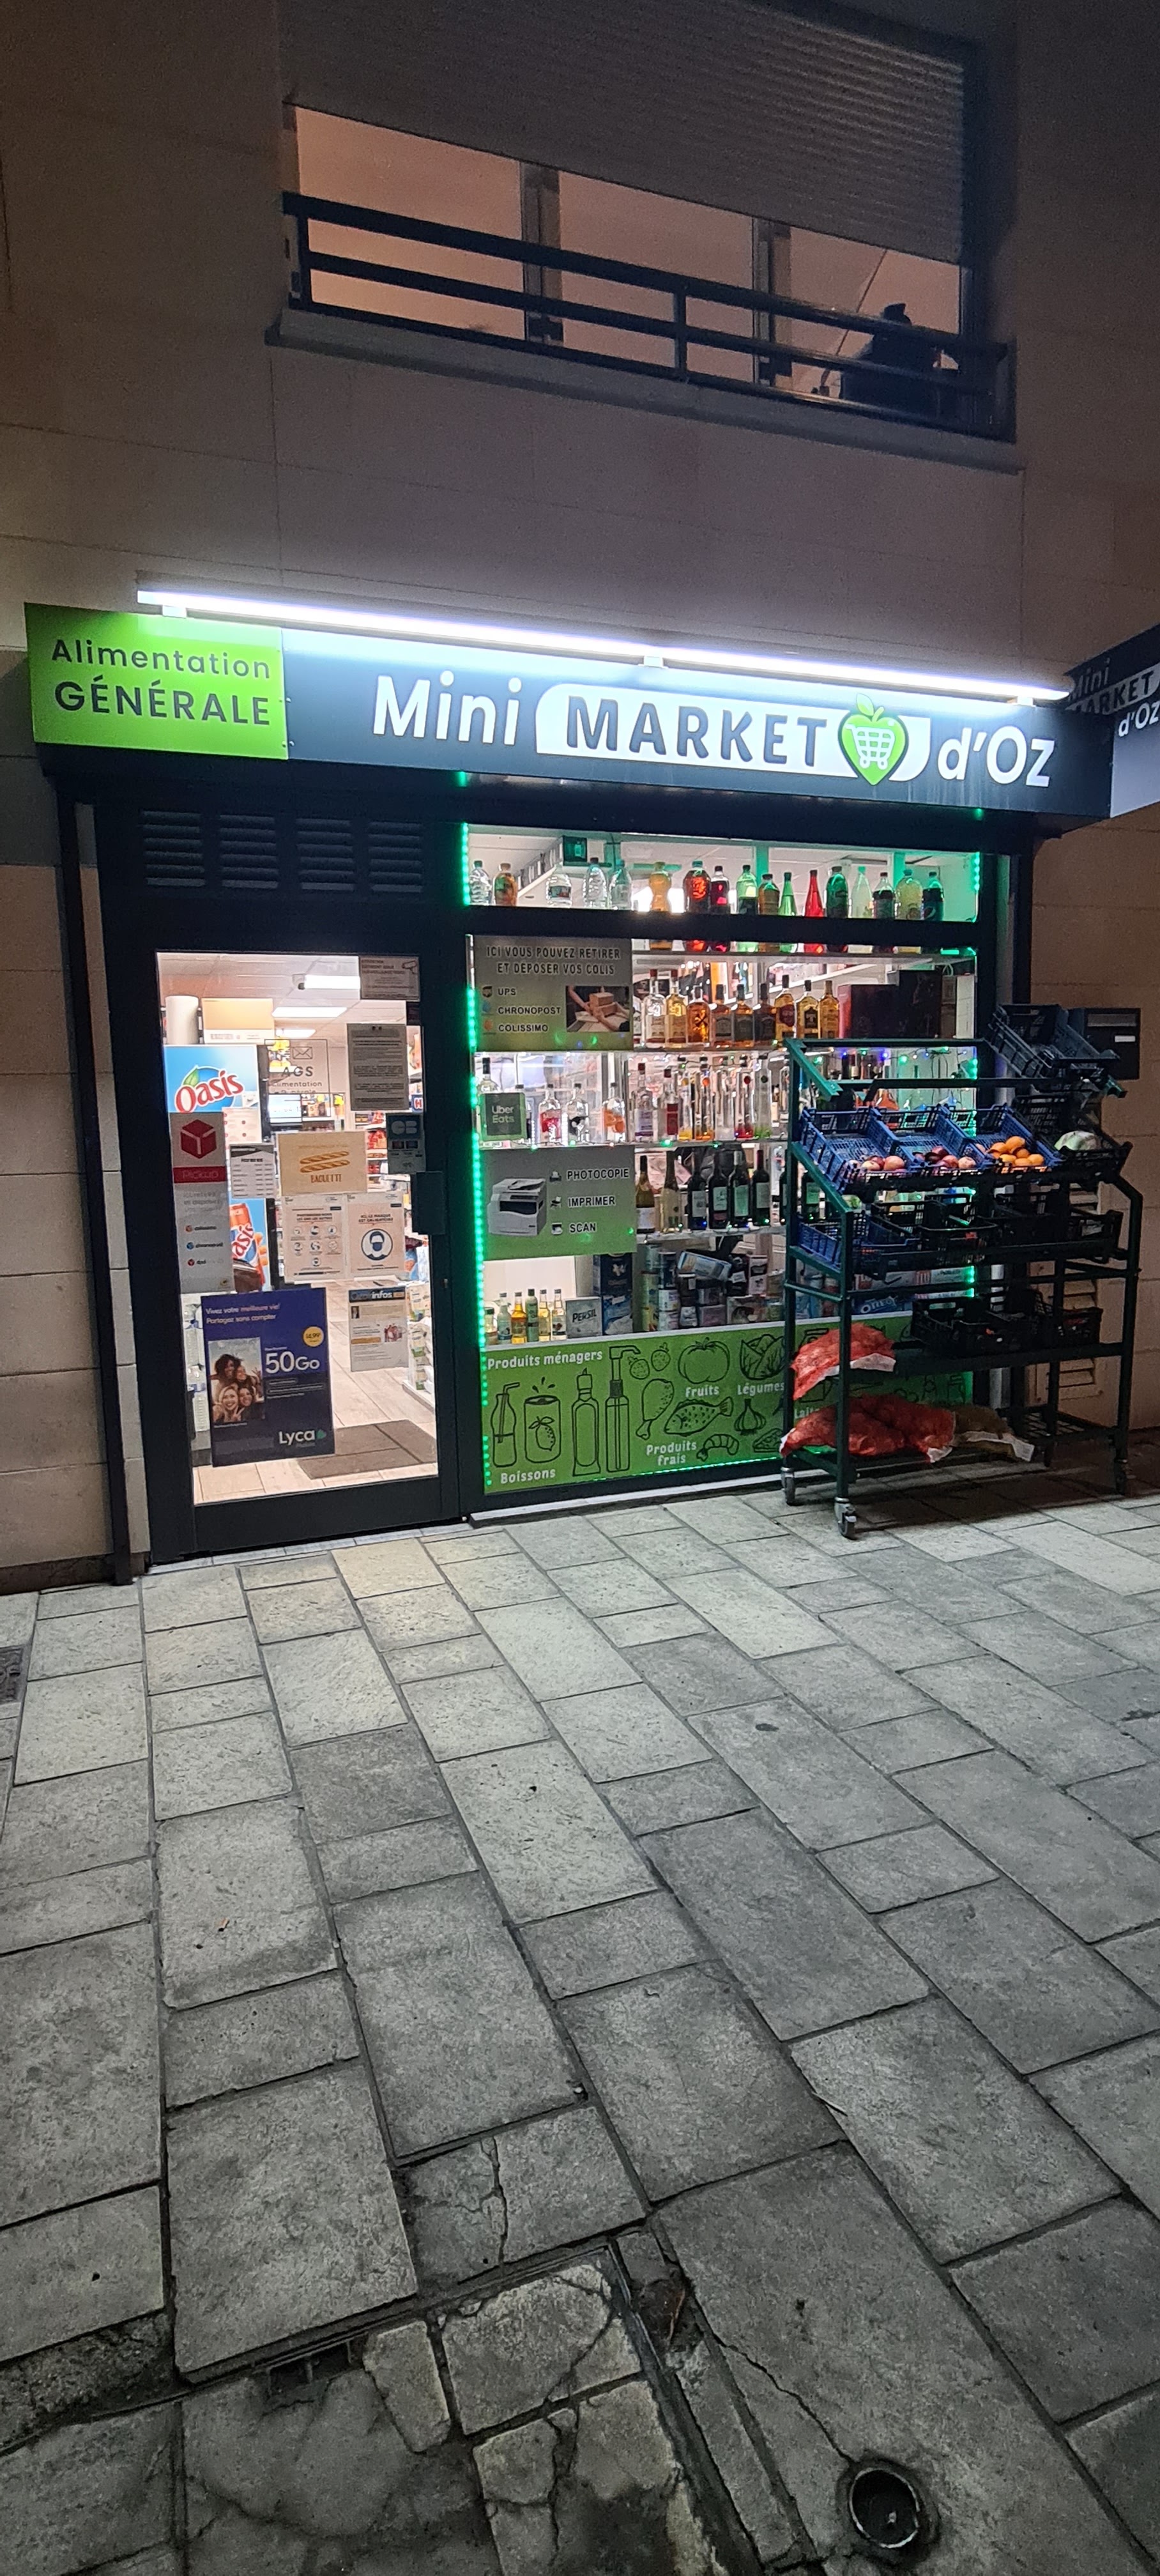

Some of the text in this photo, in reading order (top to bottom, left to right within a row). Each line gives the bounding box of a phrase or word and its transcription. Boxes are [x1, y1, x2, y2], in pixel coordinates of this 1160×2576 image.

[52, 640, 270, 679] Alimentation
[54, 675, 270, 726] GÉNÉRALE
[374, 670, 1058, 787] Mini MARKET d'Oz
[487, 946, 620, 959] ICI VOUS POUVEZ RETIRER
[497, 963, 509, 974] ET
[563, 964, 583, 974] VOS
[586, 964, 614, 975] COLIS
[498, 988, 516, 996] UPS
[498, 1006, 561, 1015] CHRONOPOST
[498, 1023, 549, 1032] COLISSIMO
[175, 1070, 244, 1113] Oasis
[491, 1105, 514, 1114] Uber
[492, 1114, 515, 1123] Eats
[567, 1168, 630, 1180] PHOTOCOPIE
[569, 1196, 616, 1207] IMPRIMER
[570, 1223, 597, 1232] SCAN
[231, 1222, 254, 1259] asis
[487, 1349, 603, 1370] Produits ménagers
[685, 1382, 784, 1398] Fruits Légumes
[278, 1430, 316, 1446] Lyca
[646, 1440, 698, 1456] Produits
[657, 1453, 687, 1466] frais
[501, 1469, 556, 1484] Boissons
